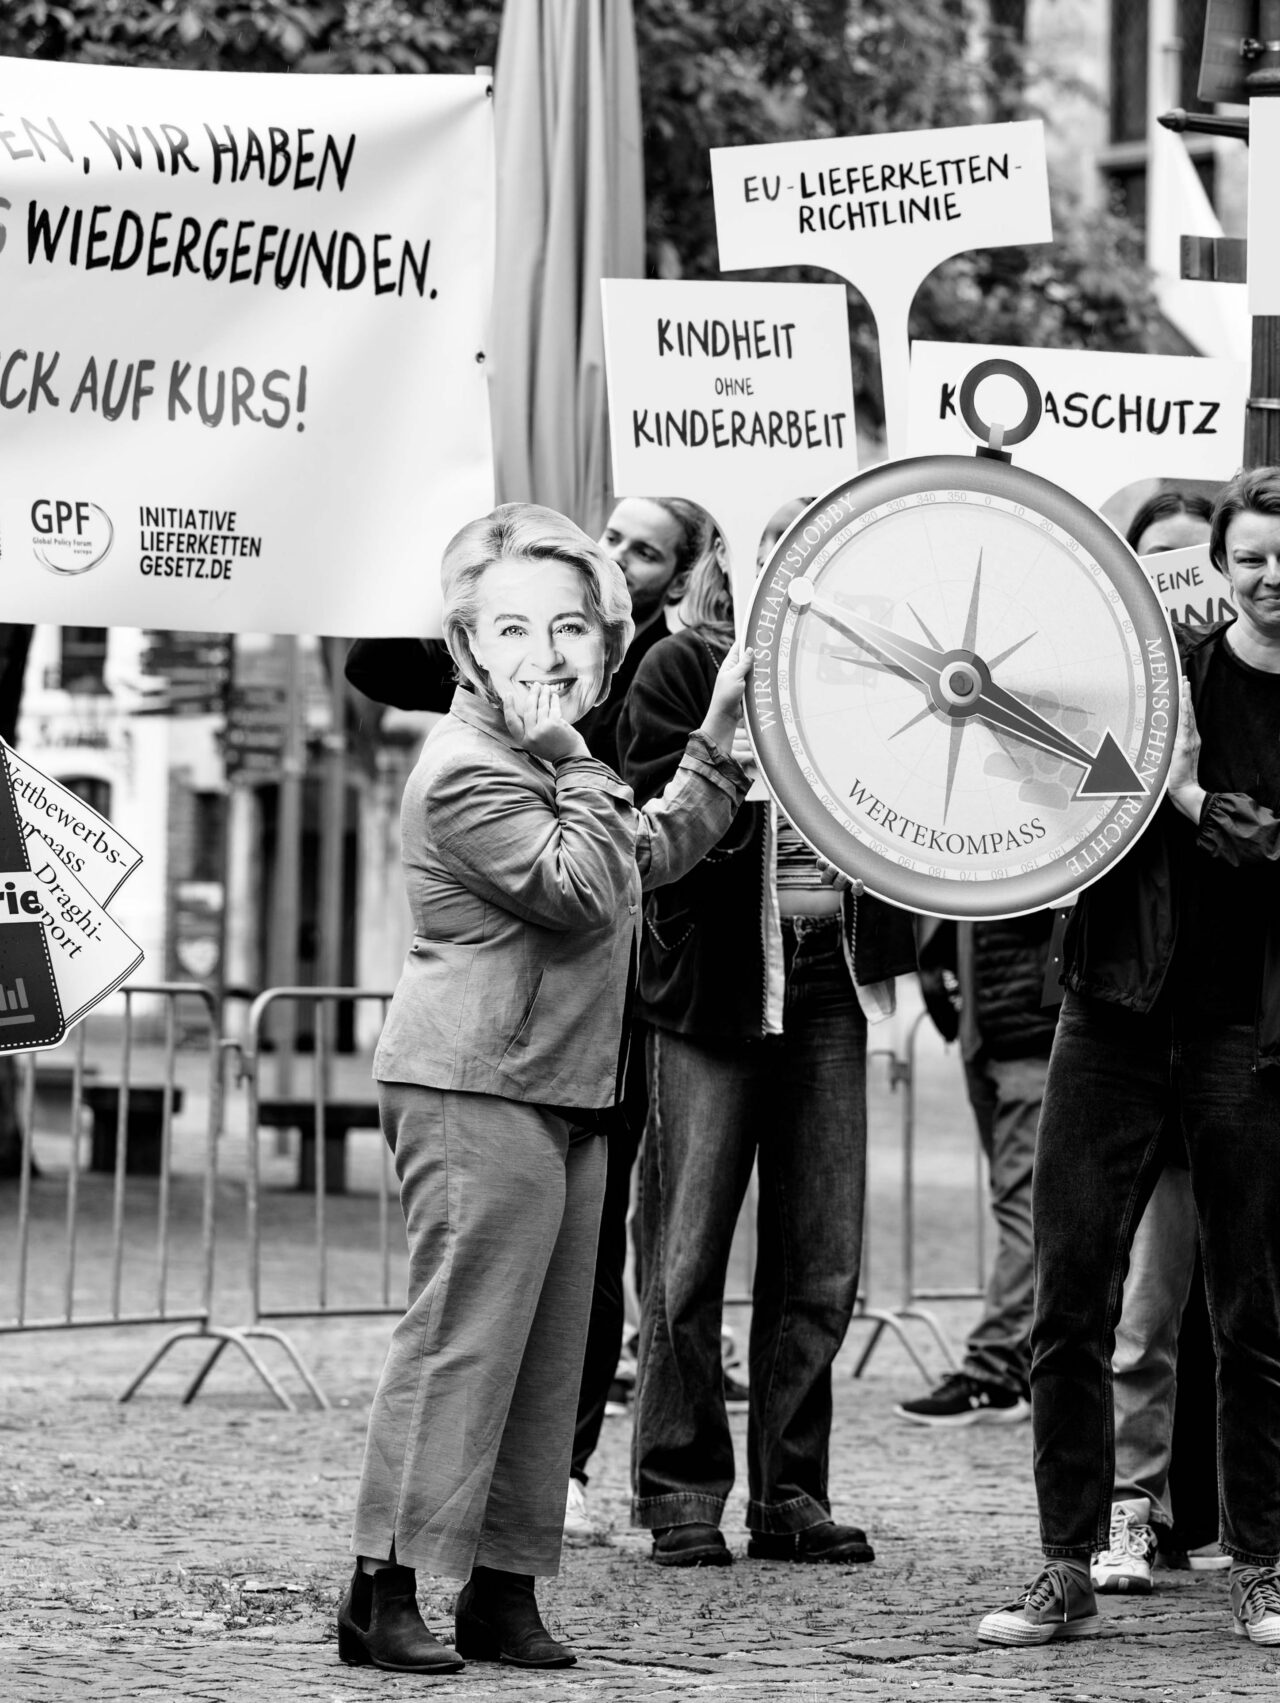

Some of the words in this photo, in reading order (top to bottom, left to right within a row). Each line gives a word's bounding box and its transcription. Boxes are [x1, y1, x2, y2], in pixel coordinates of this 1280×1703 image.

[89, 120, 200, 176] WIR
[203, 122, 356, 192] HABEN
[799, 192, 962, 233] RICHTLINIE
[27, 200, 438, 300] WIEDERGEFUNDEN.
[657, 317, 796, 359] KINDHEIT
[0, 348, 61, 414] CK
[70, 356, 156, 421] AUF
[167, 358, 308, 433] KURS!
[714, 377, 754, 396] OHNE
[940, 383, 1221, 436] KASCHUTZ
[632, 408, 846, 448] KINDERARBEIT
[886, 499, 906, 512] 330
[916, 493, 936, 505] 340
[947, 492, 967, 502] 350
[31, 499, 90, 535] GPF
[140, 506, 237, 532] INITIATIVE
[859, 511, 878, 527] 320
[1012, 504, 1025, 516] 10
[1039, 519, 1054, 532] 20
[140, 530, 262, 557] LIEFERKETTEN
[834, 528, 853, 545] 310
[1066, 538, 1079, 552] 30
[140, 555, 233, 580] GESETZ.DE
[814, 551, 830, 569] 300
[1089, 563, 1102, 577] 40
[1151, 566, 1204, 593] EINE
[1108, 590, 1120, 604] 50
[753, 492, 856, 732] WIRTSCHAFTSLOBBY
[786, 605, 799, 626] 280
[1122, 620, 1133, 634] 60
[780, 637, 790, 658] 270
[1132, 652, 1142, 666] 70
[1136, 684, 1145, 698] 80
[782, 703, 793, 724] 250
[1135, 717, 1143, 731] 90
[789, 736, 803, 756] 240
[821, 794, 838, 814] 220
[848, 778, 1046, 855] WERTEKOMPASS
[843, 819, 862, 838] 210
[868, 840, 888, 856] 200
[898, 856, 916, 870] 190
[928, 866, 946, 879] 180
[1021, 859, 1038, 873] 150
[960, 871, 978, 881] 170
[991, 868, 1009, 880] 160
[0, 882, 42, 914] ie
[33, 862, 102, 942] Draghi-
